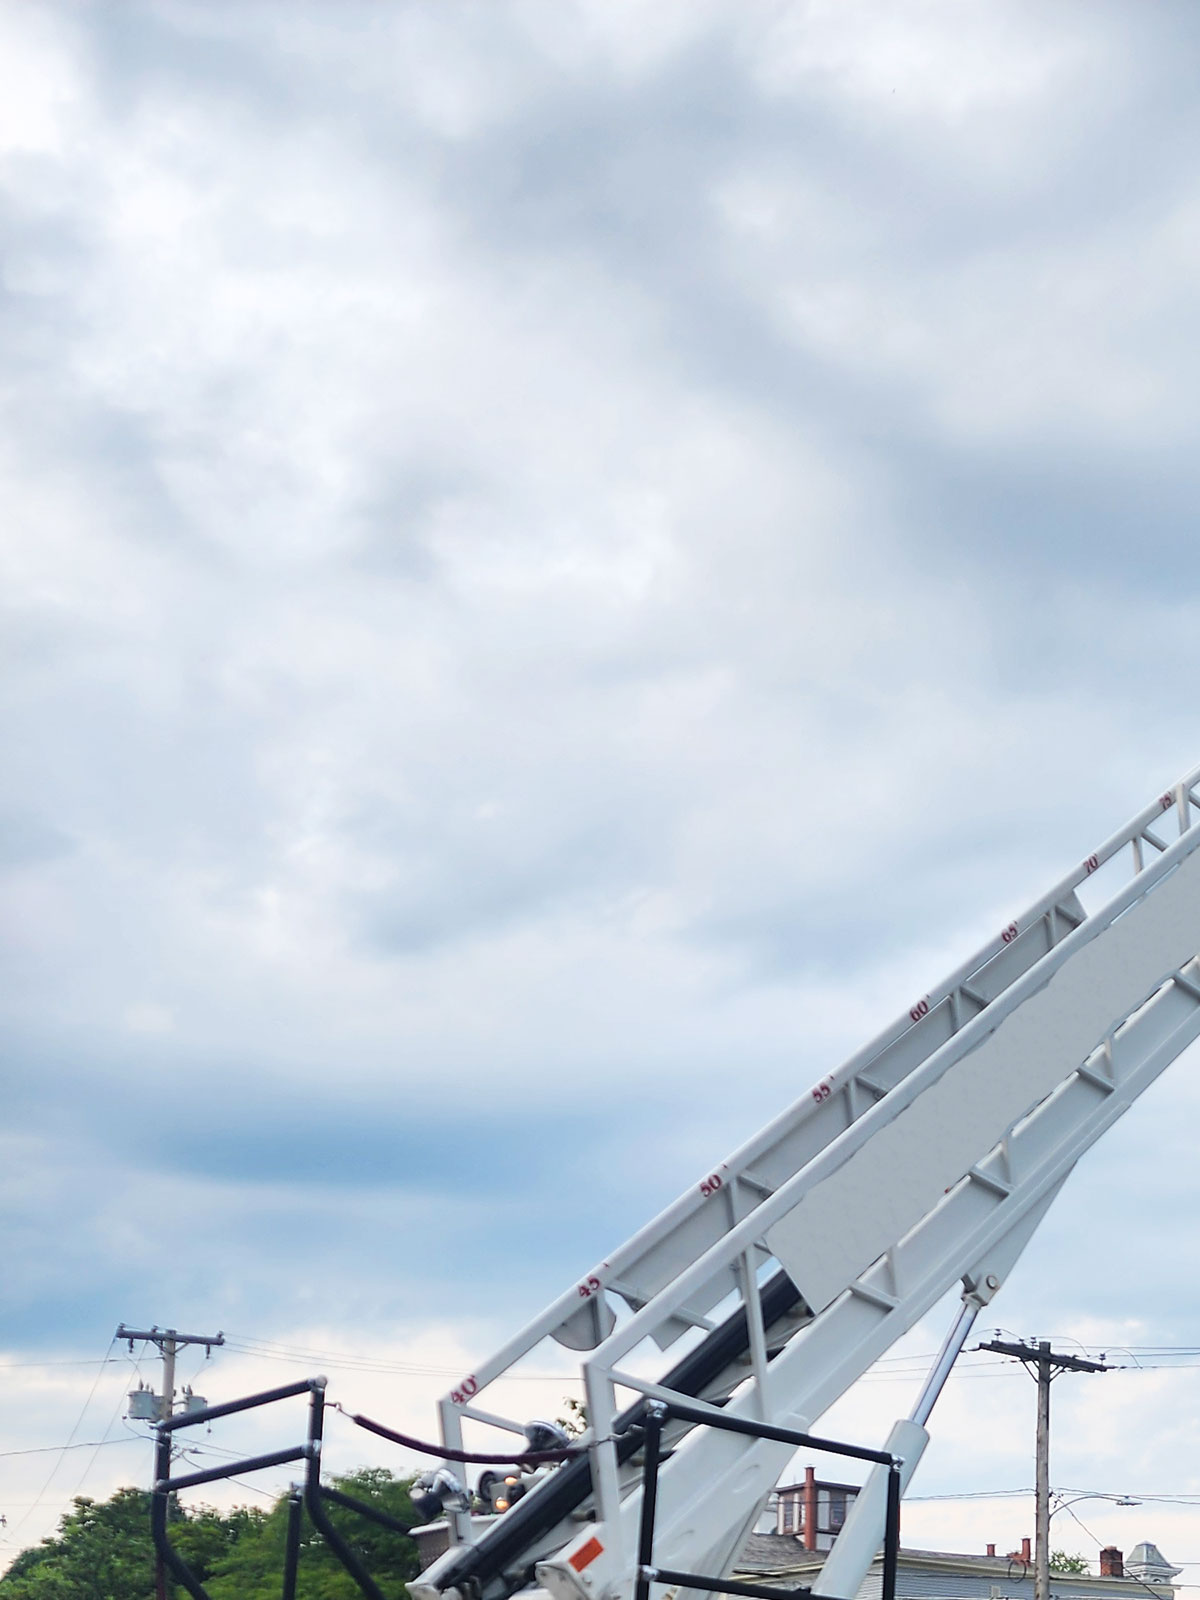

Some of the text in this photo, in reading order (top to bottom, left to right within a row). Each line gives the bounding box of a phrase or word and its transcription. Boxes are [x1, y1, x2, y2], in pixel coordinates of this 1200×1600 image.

[909, 994, 931, 1022] 60'
[812, 1074, 836, 1104] 55'
[700, 1163, 729, 1198] 50'
[450, 1373, 478, 1404] 40'
